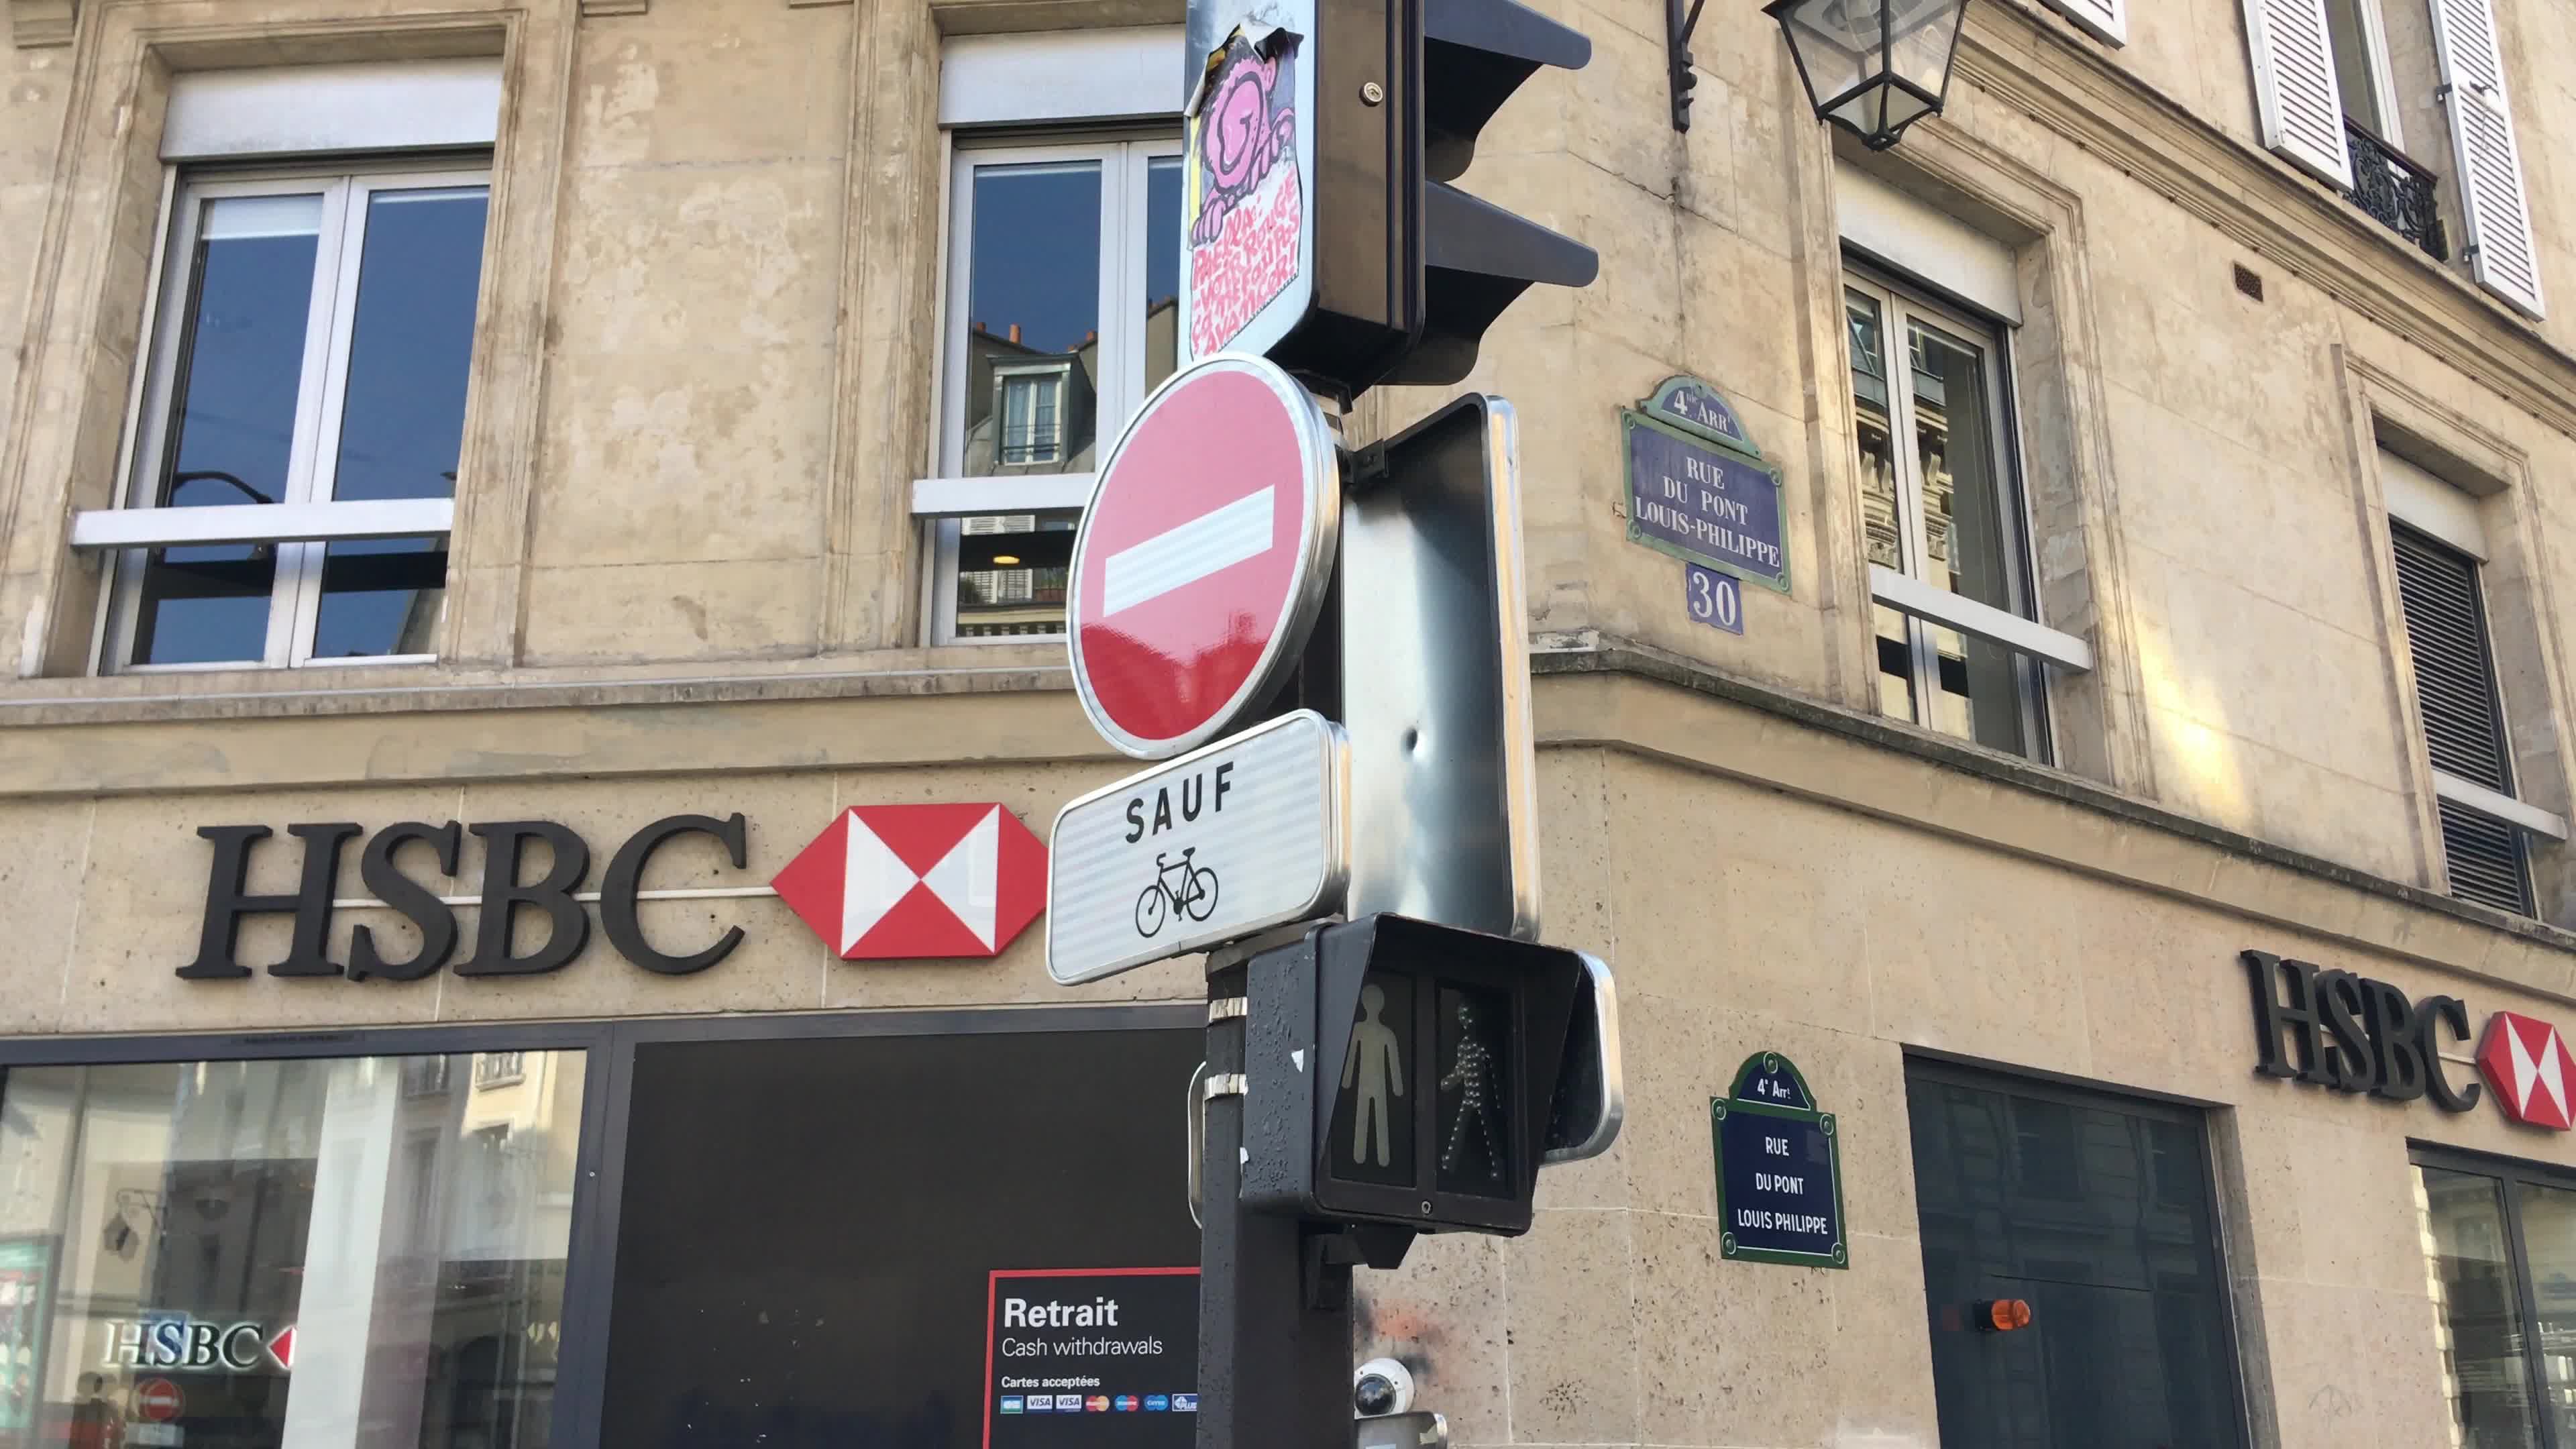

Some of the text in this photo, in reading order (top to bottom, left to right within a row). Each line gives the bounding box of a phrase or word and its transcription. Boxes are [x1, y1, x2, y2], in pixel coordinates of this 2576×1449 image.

[1686, 456, 1724, 490] RUE
[1663, 476, 1748, 525] DU PONT
[1635, 496, 1780, 568] LOUIS-PHILIPPE
[1693, 572, 1736, 627] 30
[1125, 761, 1234, 844] SAUF
[175, 812, 747, 981] HSBC
[2239, 949, 2481, 1113] HSBC
[1765, 1136, 1790, 1157] RUE
[1756, 1173, 1804, 1195] DU PONT
[1737, 1208, 1828, 1235] LOUIS PHILIPPE
[1004, 1296, 1118, 1328] Retrait
[101, 1320, 264, 1368] HSBC
[1002, 1336, 1163, 1356] Cash withdrawals
[1001, 1375, 1101, 1389] Cartes acceptées
[1030, 1397, 1051, 1407] VISA
[1059, 1397, 1080, 1407] VISA
